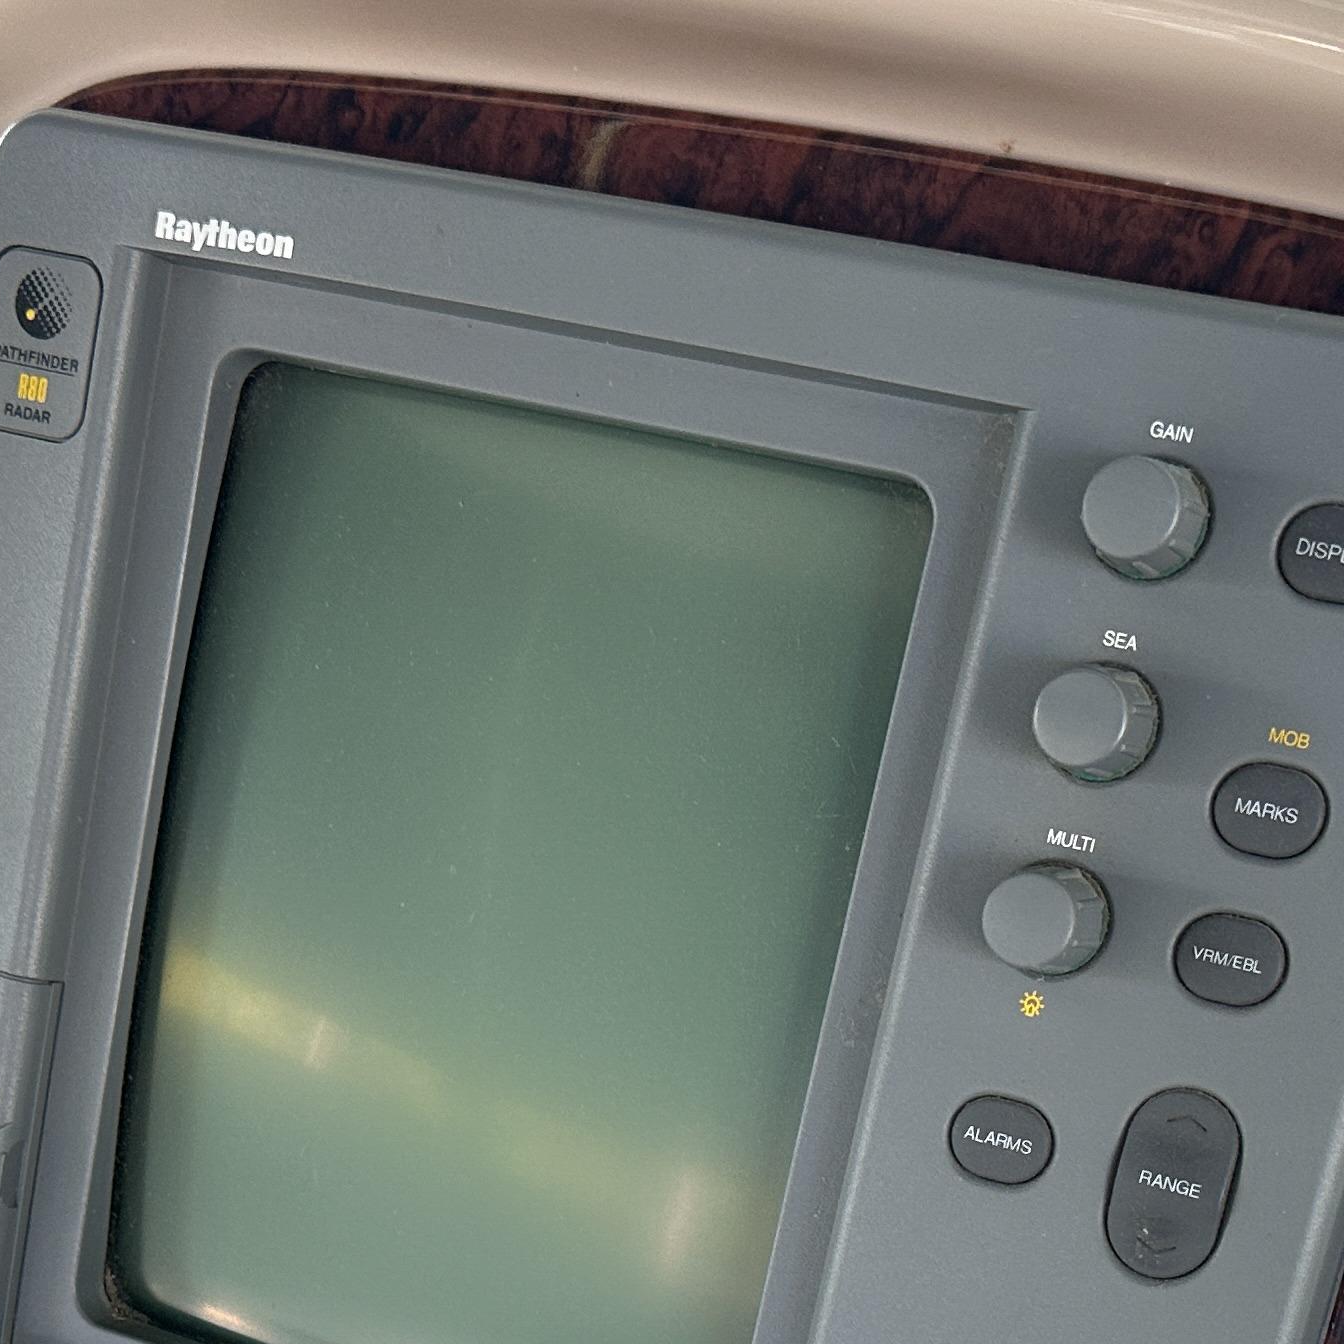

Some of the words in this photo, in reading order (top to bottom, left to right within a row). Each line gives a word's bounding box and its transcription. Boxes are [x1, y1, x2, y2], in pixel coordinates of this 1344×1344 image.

[155, 211, 294, 260] Raytheon
[3, 402, 52, 425] RADAR
[1149, 420, 1194, 444] GAIN
[1102, 629, 1138, 652] SEA
[1268, 727, 1311, 750] MOB
[1234, 797, 1299, 825] MARKS
[1046, 827, 1096, 853] MULTI
[1192, 945, 1262, 975] VRM/EBL
[963, 1124, 1034, 1155] ALARMS
[1138, 1169, 1203, 1199] RANGE
